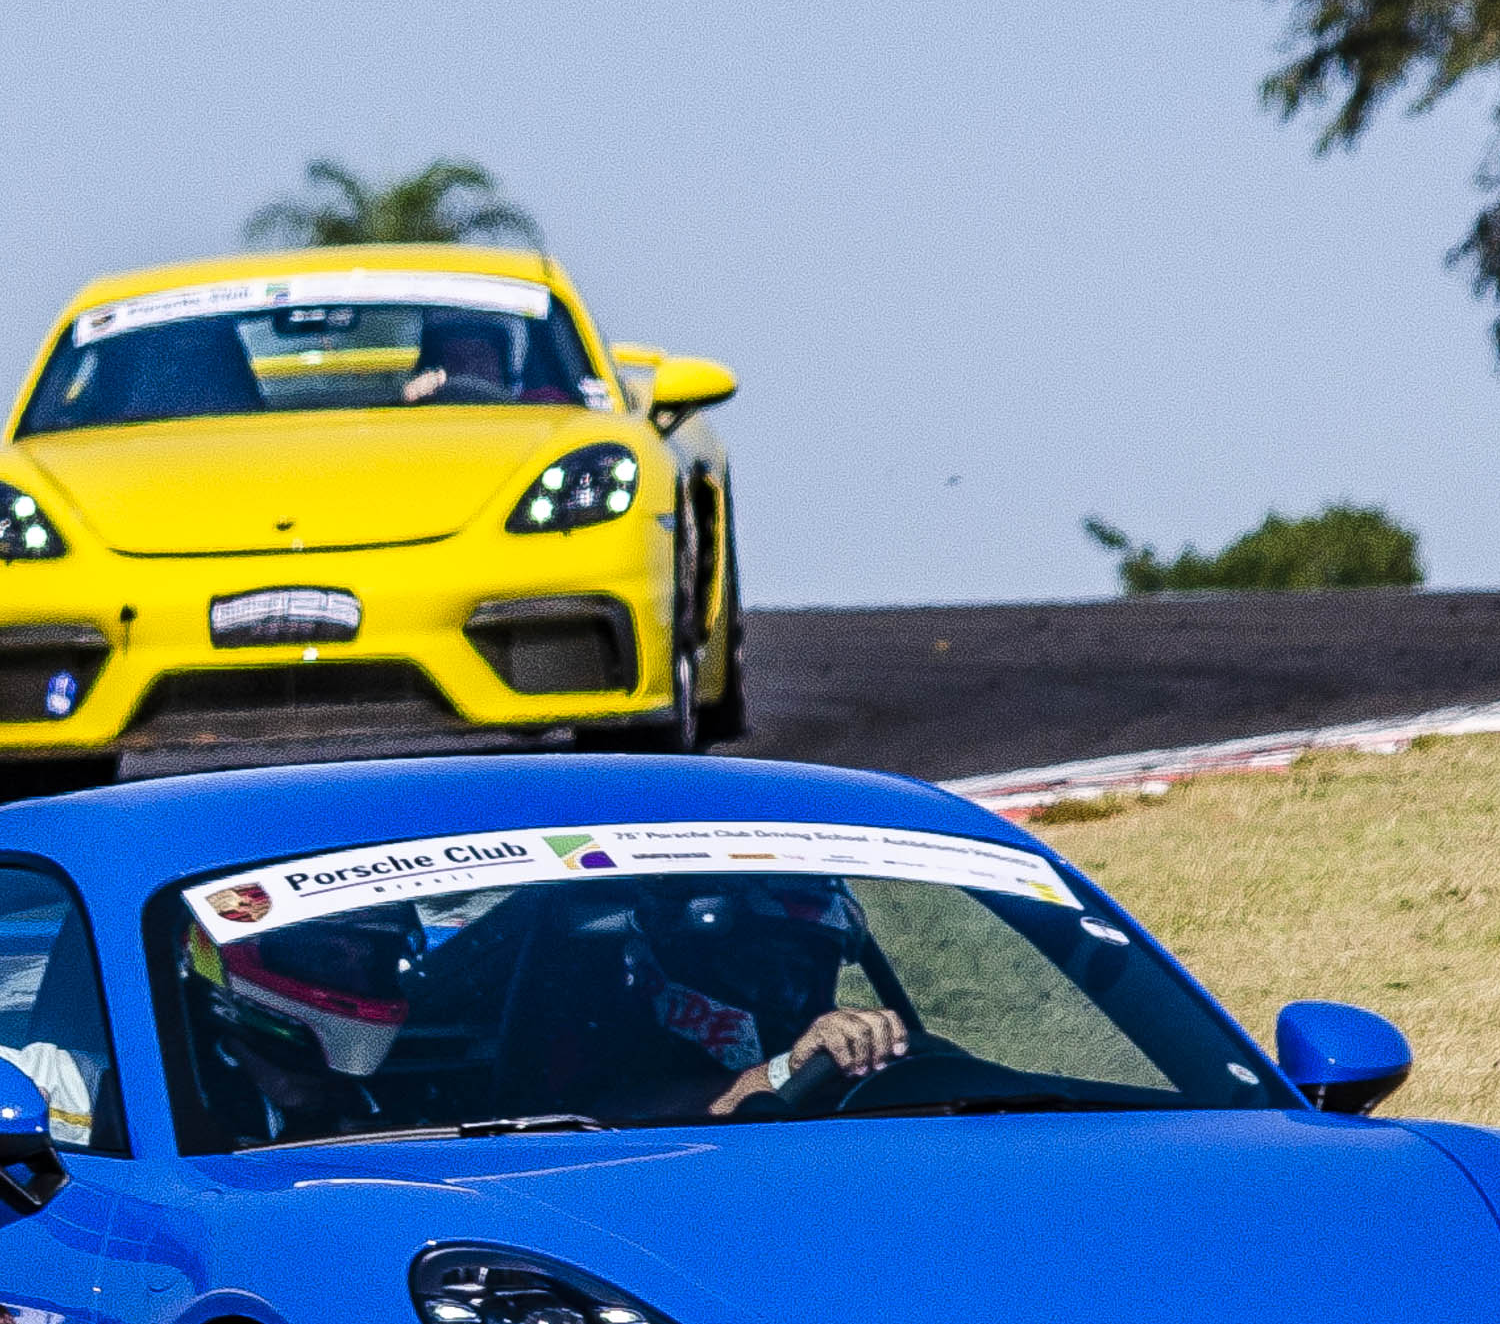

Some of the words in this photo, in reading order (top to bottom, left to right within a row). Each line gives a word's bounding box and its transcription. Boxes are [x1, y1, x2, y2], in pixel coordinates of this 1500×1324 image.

[646, 830, 711, 840] Porsche
[713, 829, 753, 838] Club
[284, 847, 434, 892] Porsche
[444, 841, 528, 864] Club
